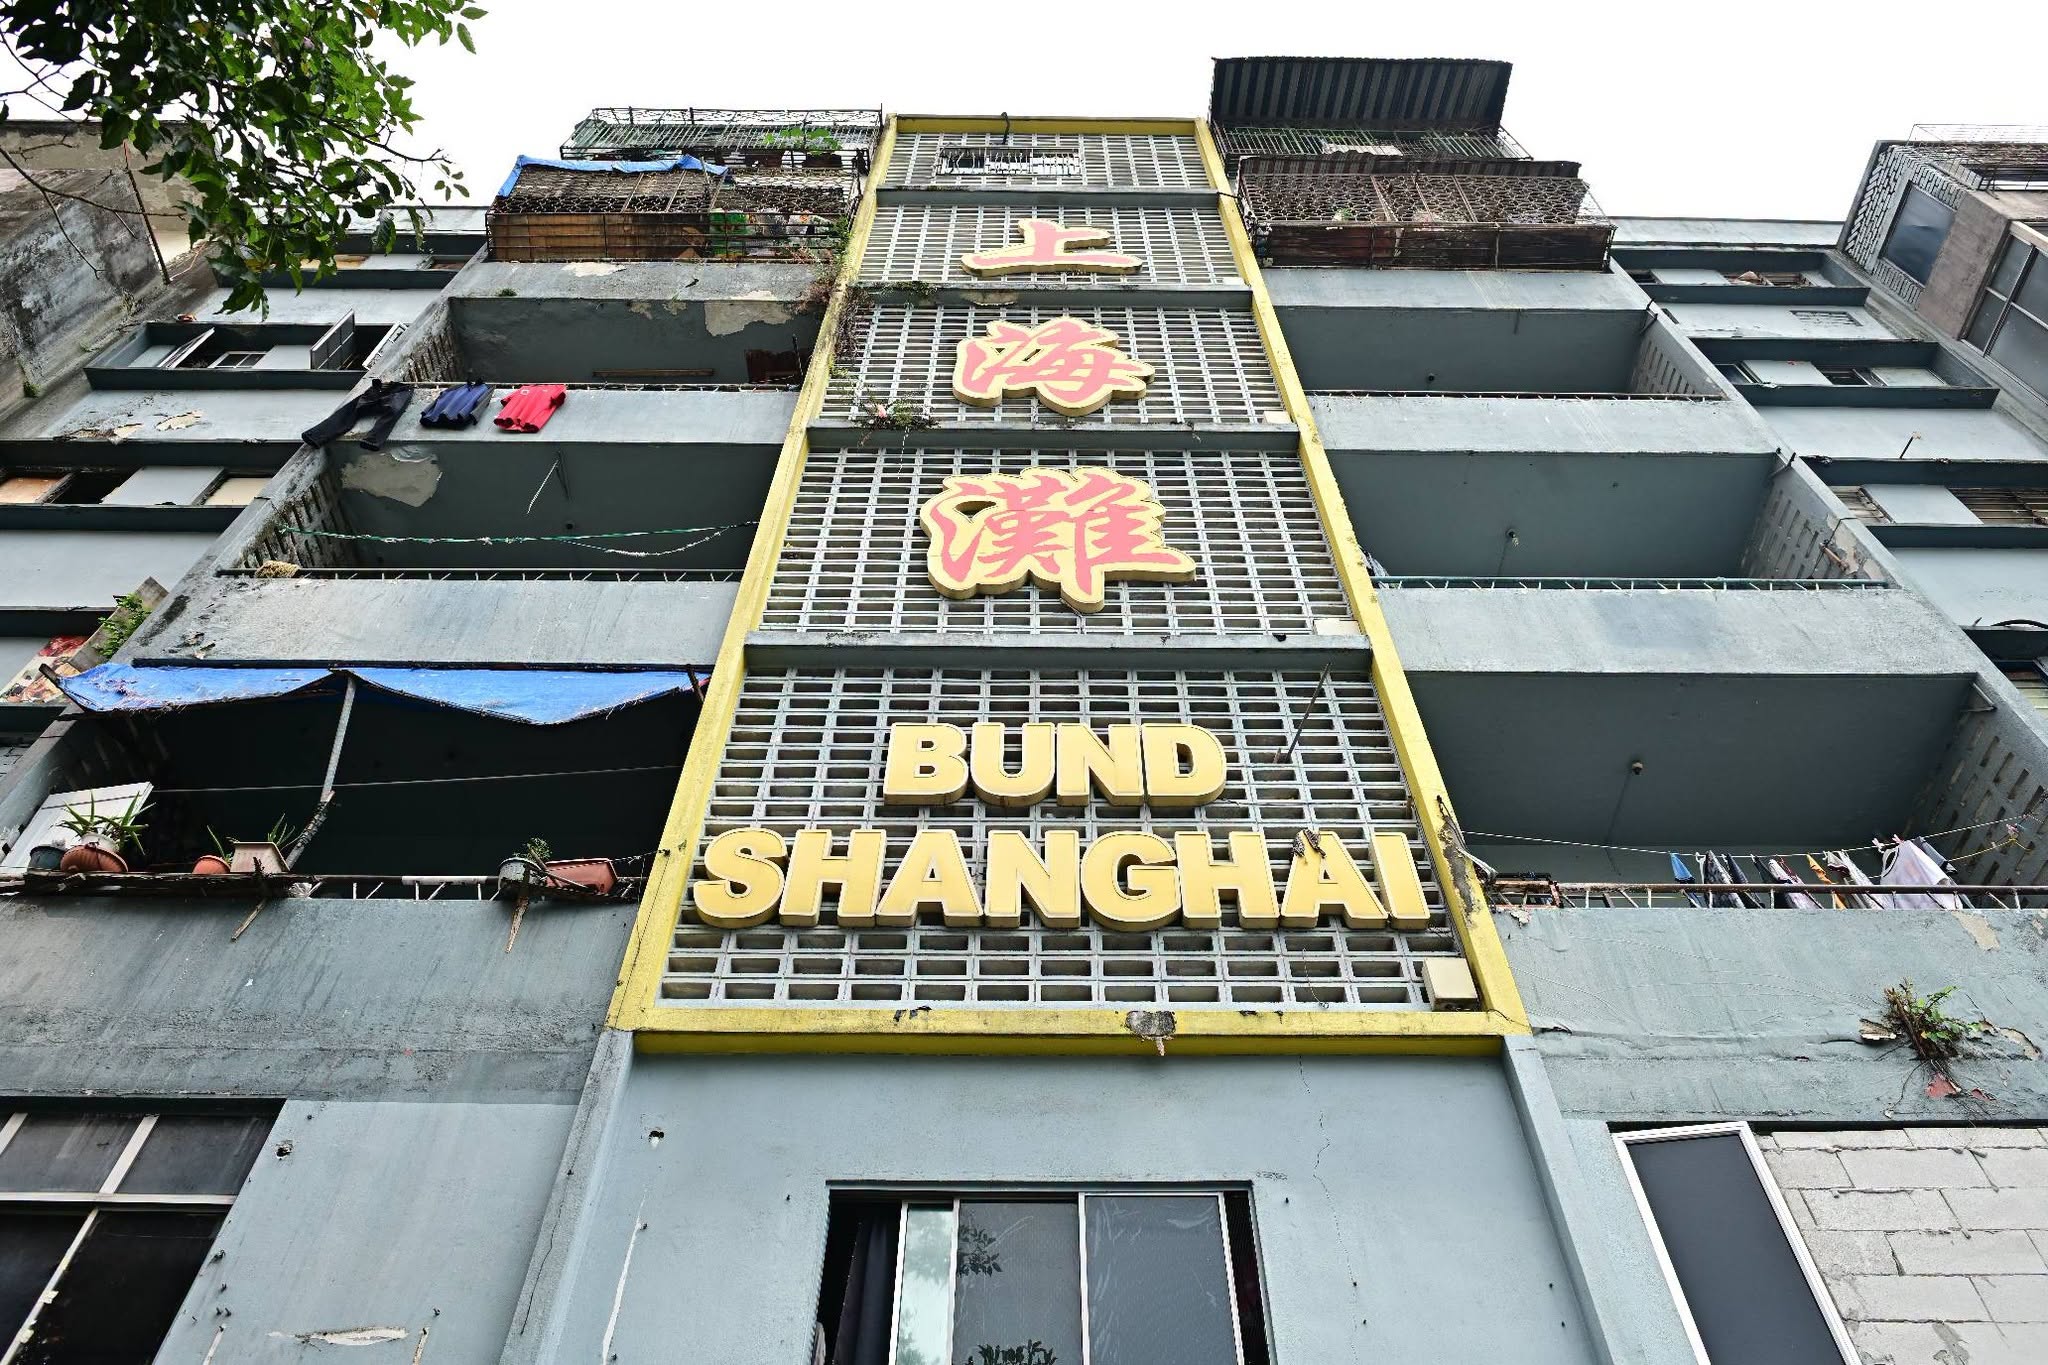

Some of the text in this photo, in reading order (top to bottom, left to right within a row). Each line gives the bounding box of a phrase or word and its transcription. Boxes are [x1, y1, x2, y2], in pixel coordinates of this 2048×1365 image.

[920, 218, 1196, 609] 上海灘
[884, 722, 1228, 804] BUND
[693, 829, 1430, 928] SHANGHAI
